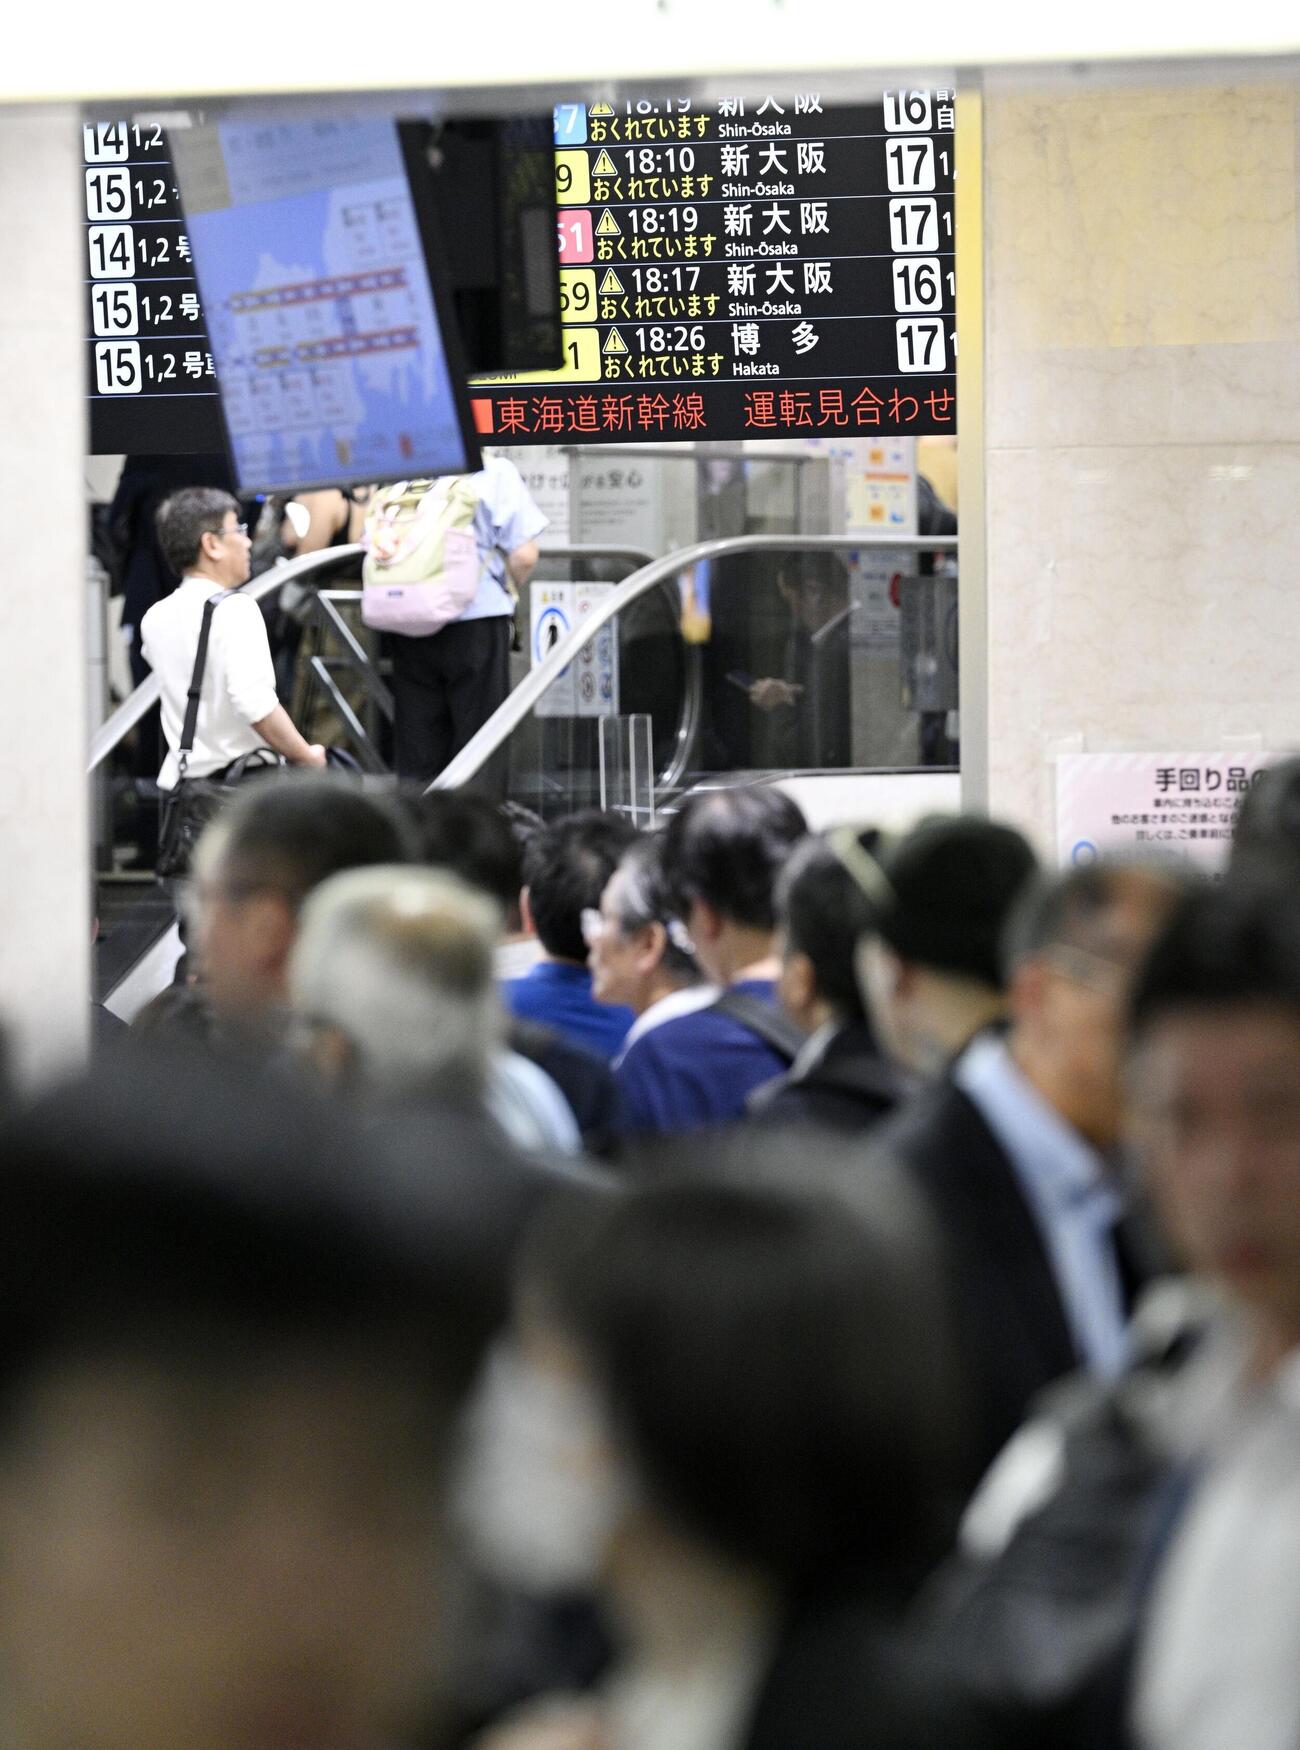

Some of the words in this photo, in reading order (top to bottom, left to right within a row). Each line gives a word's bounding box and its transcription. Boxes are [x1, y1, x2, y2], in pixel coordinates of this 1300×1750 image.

[131, 122, 164, 151] 1,2
[590, 114, 711, 142] おくれています
[625, 147, 696, 175] 18:10
[720, 142, 827, 177] 新大阪
[890, 144, 928, 186] 17
[90, 174, 126, 214] 15
[135, 179, 167, 209] 1,2
[593, 173, 714, 201] おくれています
[628, 206, 698, 234] 18:19
[723, 202, 830, 237] 新大阪
[893, 204, 932, 246] 17
[93, 232, 130, 271] 14
[597, 233, 717, 261] おくれています
[631, 266, 701, 293] 18:17
[727, 261, 834, 297] 新大阪
[897, 264, 937, 306] 16
[96, 290, 132, 329] 15
[601, 293, 721, 320] おくれています
[635, 325, 706, 353] 18:26
[900, 324, 939, 366] 17
[100, 347, 136, 387] 15
[567, 341, 580, 370] 1
[604, 352, 724, 379] おくれています
[732, 361, 780, 377] Hakata
[496, 391, 707, 434] 東海道新幹線
[744, 386, 955, 428] 運転見合わせ
